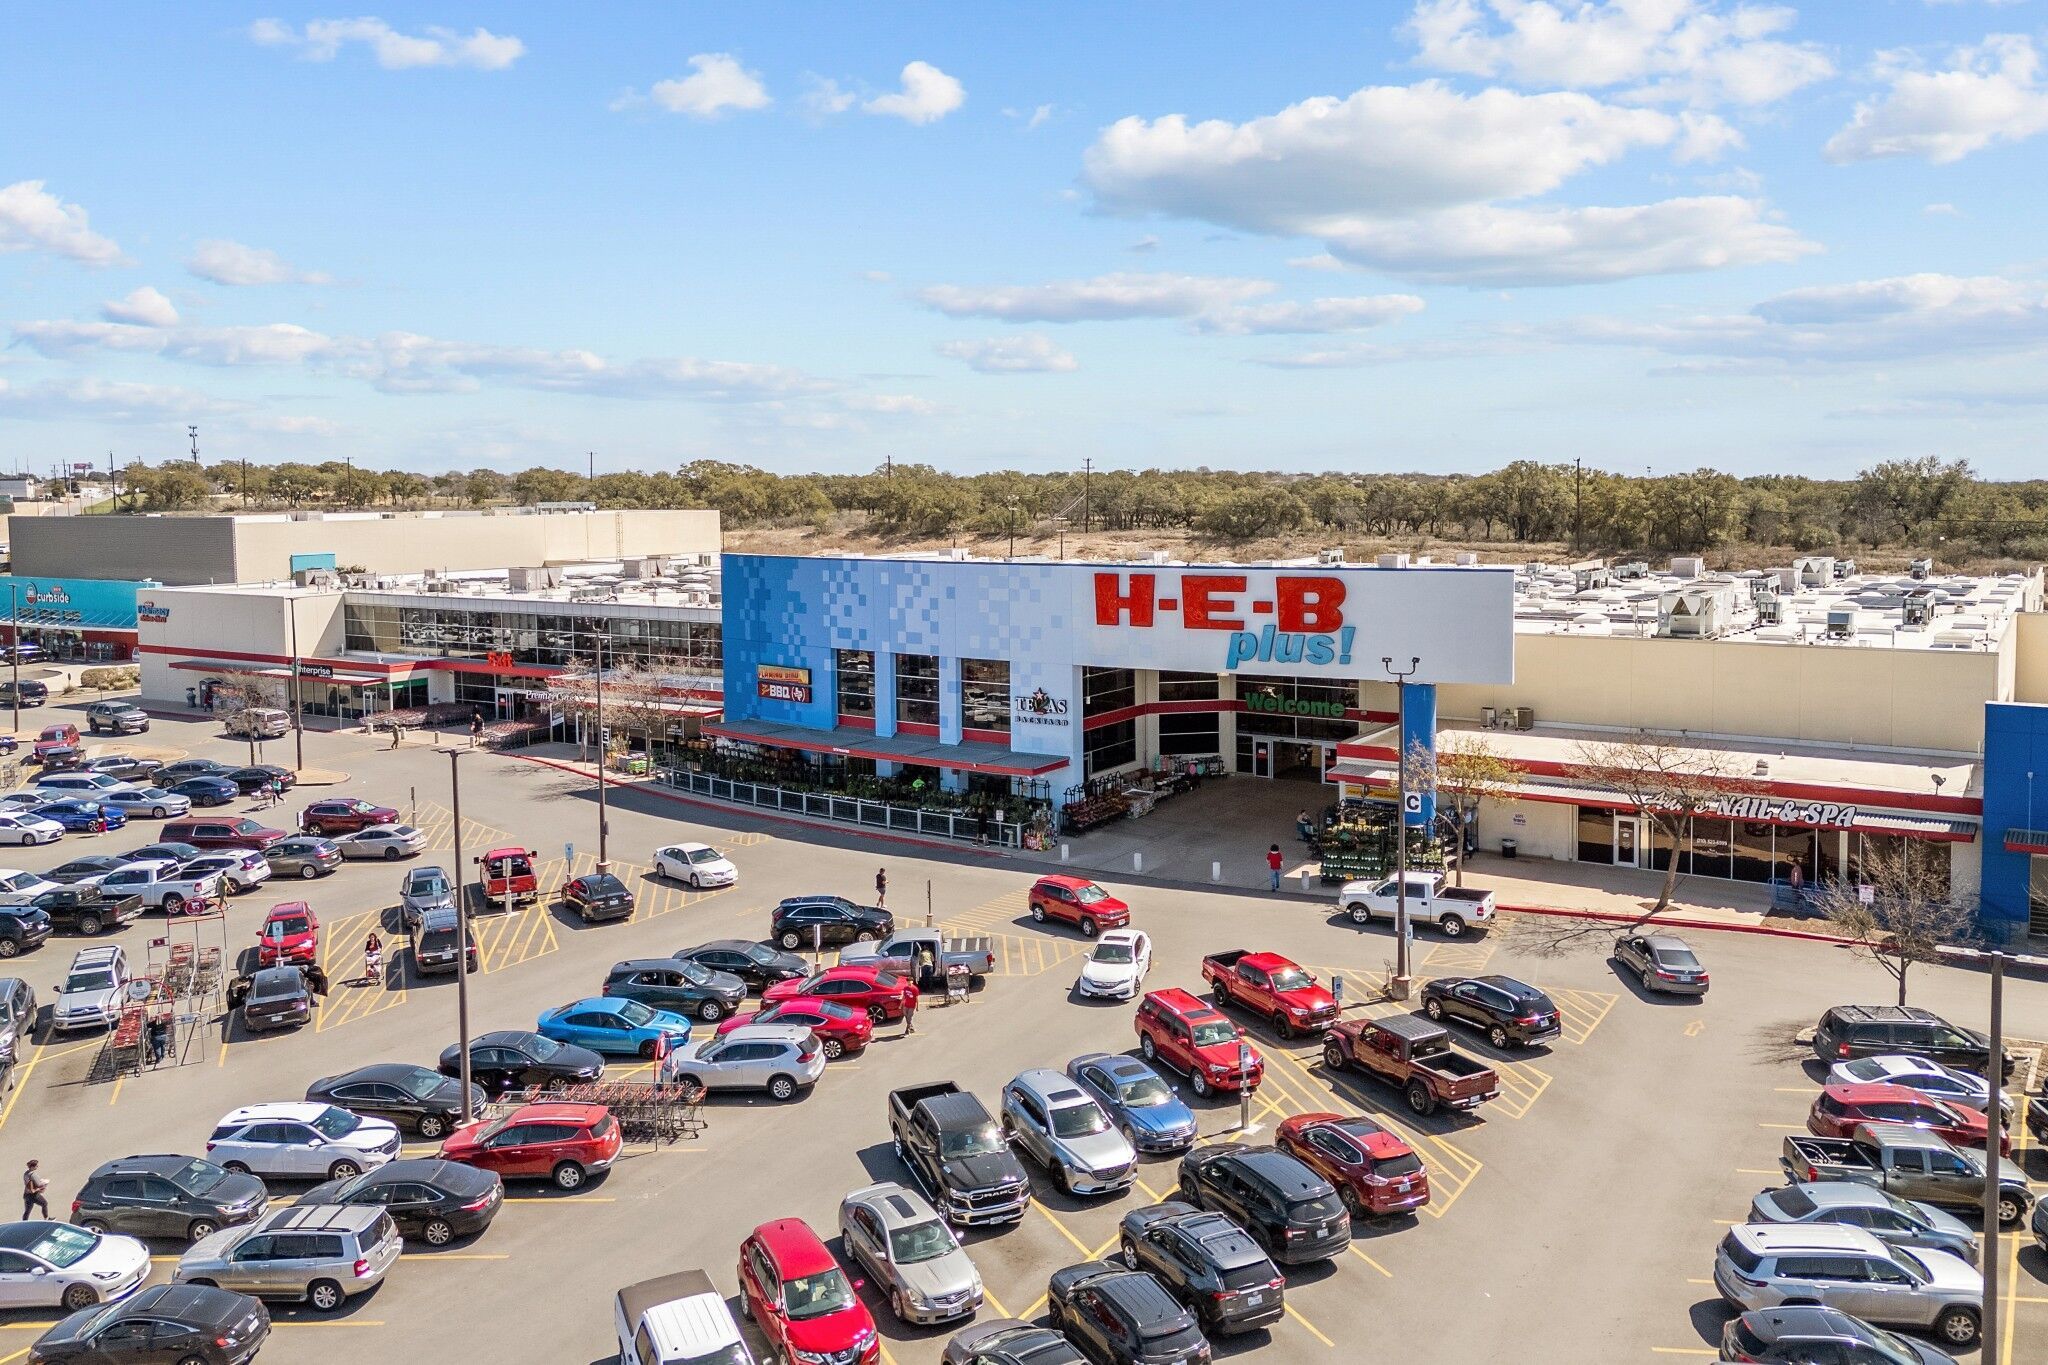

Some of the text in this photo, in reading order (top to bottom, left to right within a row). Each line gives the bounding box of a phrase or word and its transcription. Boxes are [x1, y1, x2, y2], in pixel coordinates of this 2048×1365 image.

[36, 592, 70, 604] curbside
[1094, 572, 1347, 633] H-E-B
[1226, 624, 1357, 670] plus!
[300, 666, 331, 676] nterprise
[769, 684, 791, 699] BBQ
[1245, 692, 1346, 717] Welcome
[1015, 715, 1069, 727] BACKYARD
[1406, 795, 1420, 811] C
[1716, 794, 1773, 820] NAIL
[1803, 802, 1857, 828] SPA
